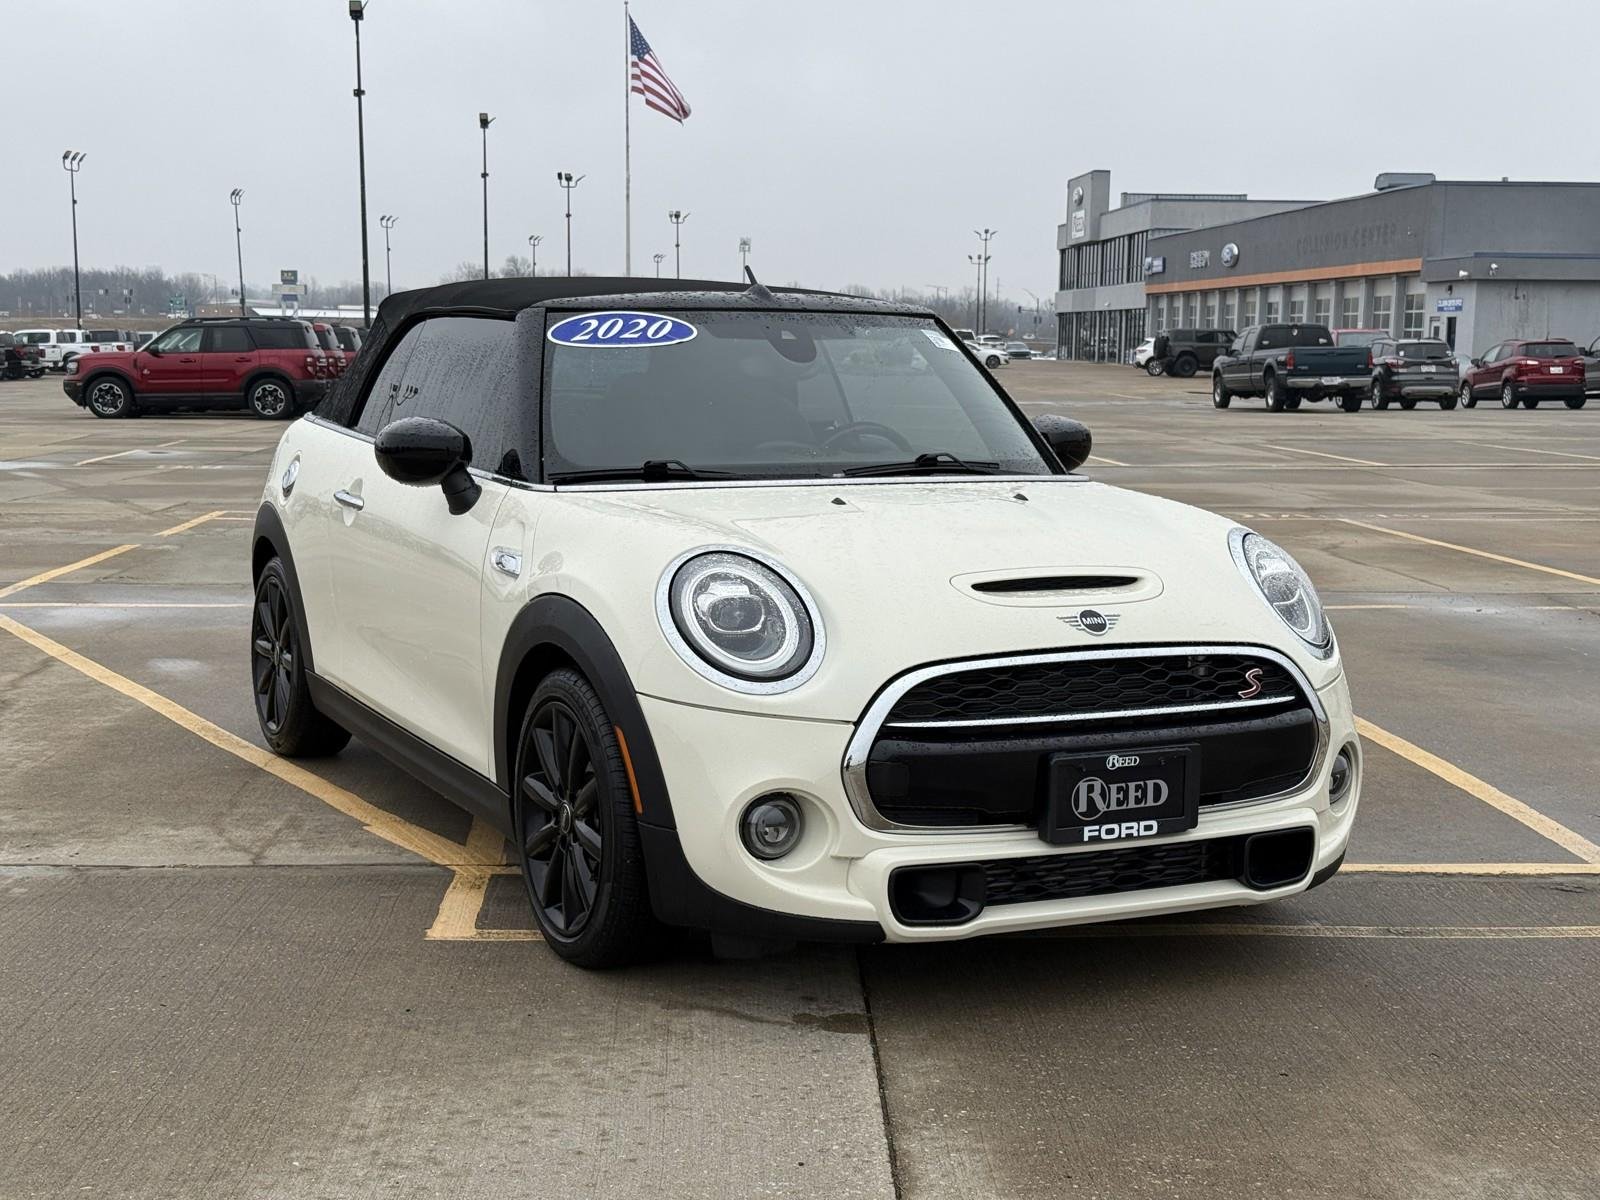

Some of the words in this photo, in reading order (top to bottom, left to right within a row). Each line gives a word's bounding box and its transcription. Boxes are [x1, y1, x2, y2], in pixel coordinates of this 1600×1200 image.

[570, 318, 673, 341] 2020
[1081, 616, 1105, 625] MINI
[1238, 668, 1263, 699] S
[1106, 755, 1140, 770] REED
[1074, 778, 1169, 816] REED
[1083, 820, 1158, 842] FORD
